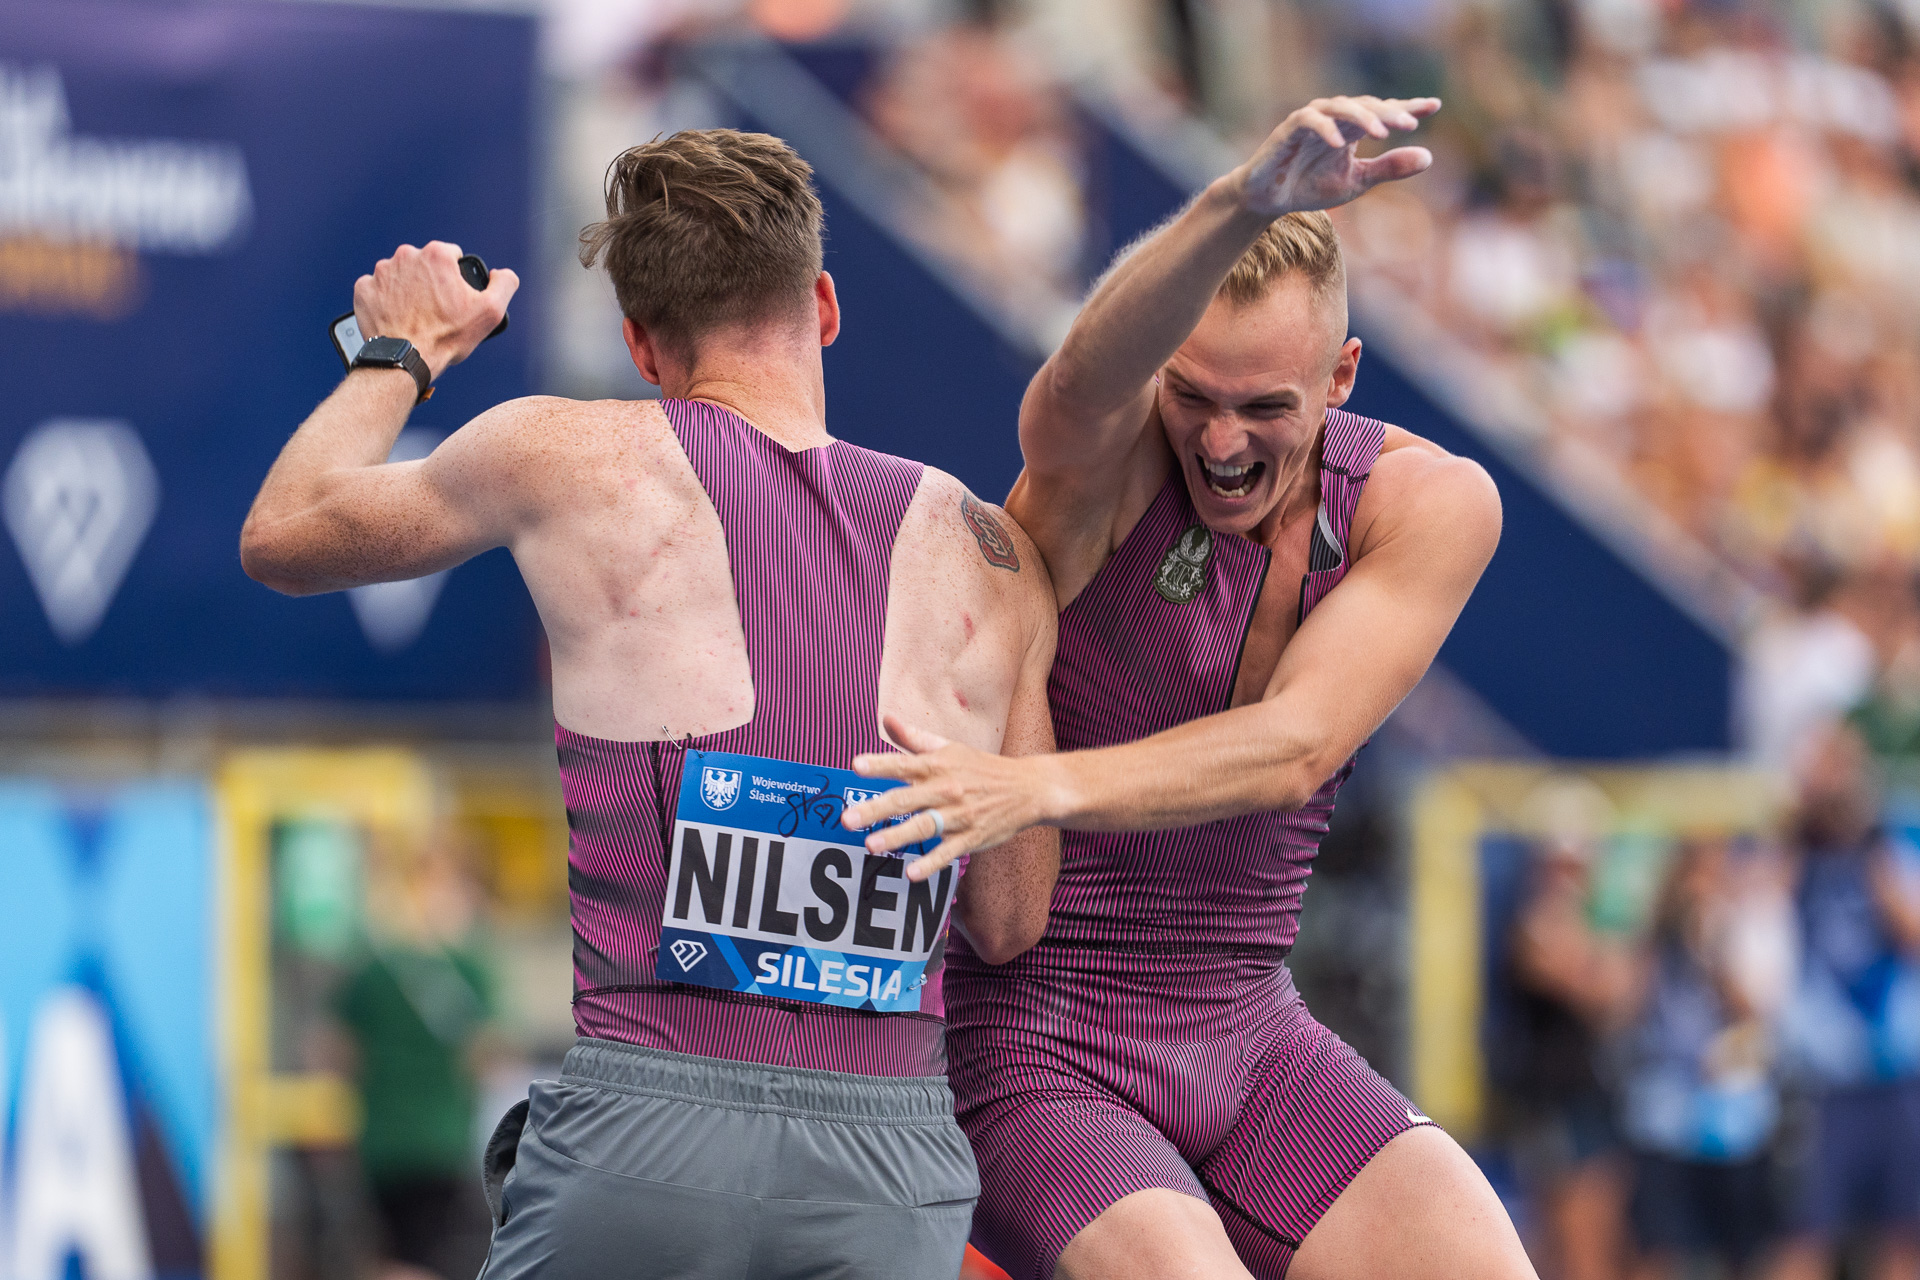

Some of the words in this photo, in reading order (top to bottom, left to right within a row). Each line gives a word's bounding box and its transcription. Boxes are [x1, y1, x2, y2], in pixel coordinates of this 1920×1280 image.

[748, 788, 786, 804] Śląskie
[751, 775, 821, 795] Województwo
[672, 827, 953, 953] NILSEN
[755, 951, 902, 1000] SILESIA
